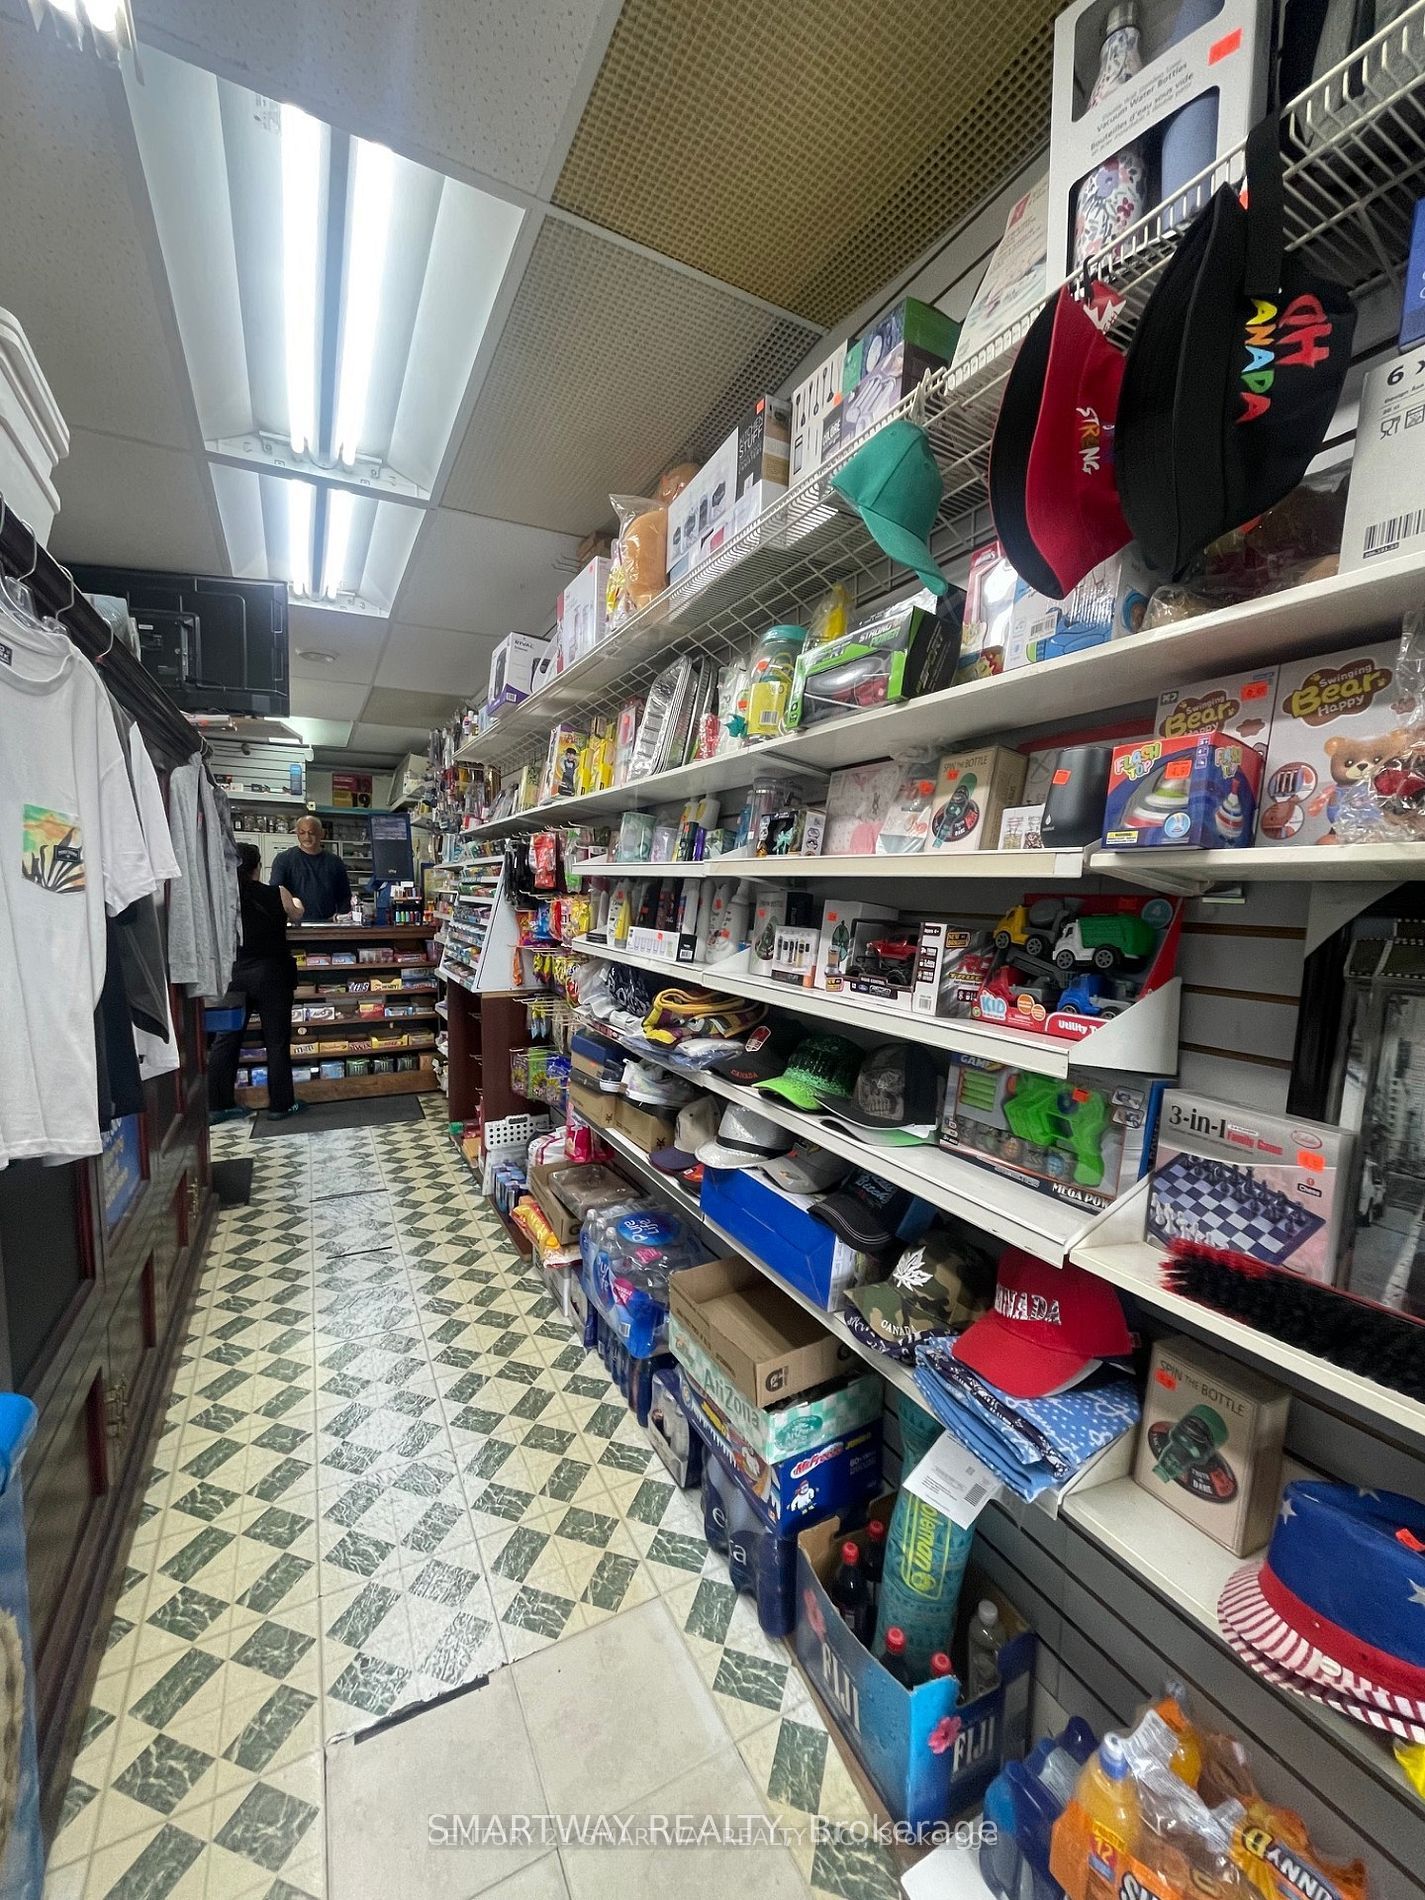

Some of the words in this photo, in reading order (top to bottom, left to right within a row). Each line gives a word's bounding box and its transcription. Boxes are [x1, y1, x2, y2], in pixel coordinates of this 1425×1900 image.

[1129, 85, 1155, 108] Water
[1157, 62, 1188, 88] Bottles
[1235, 299, 1278, 426] ANADA
[1387, 365, 1404, 387] 6
[1319, 663, 1373, 689] Swinging
[1186, 694, 1225, 715] Swinging
[1291, 668, 1384, 719] Bear
[1318, 694, 1365, 718] Happy
[1165, 700, 1232, 738] Bear
[965, 755, 988, 769] BOTTLE
[1115, 742, 1162, 775] FLASH
[1127, 759, 1153, 780] TOP
[981, 993, 1006, 1015] KID
[1058, 1019, 1088, 1034] Utility
[1052, 1182, 1082, 1203] MEGA
[1084, 1191, 1111, 1211] POW
[994, 1284, 1063, 1326] NADA
[880, 1319, 913, 1336] CANAD
[1200, 1383, 1246, 1418] BOTTLE
[911, 1502, 938, 1573] oleman
[952, 1715, 996, 1774] FIJI
